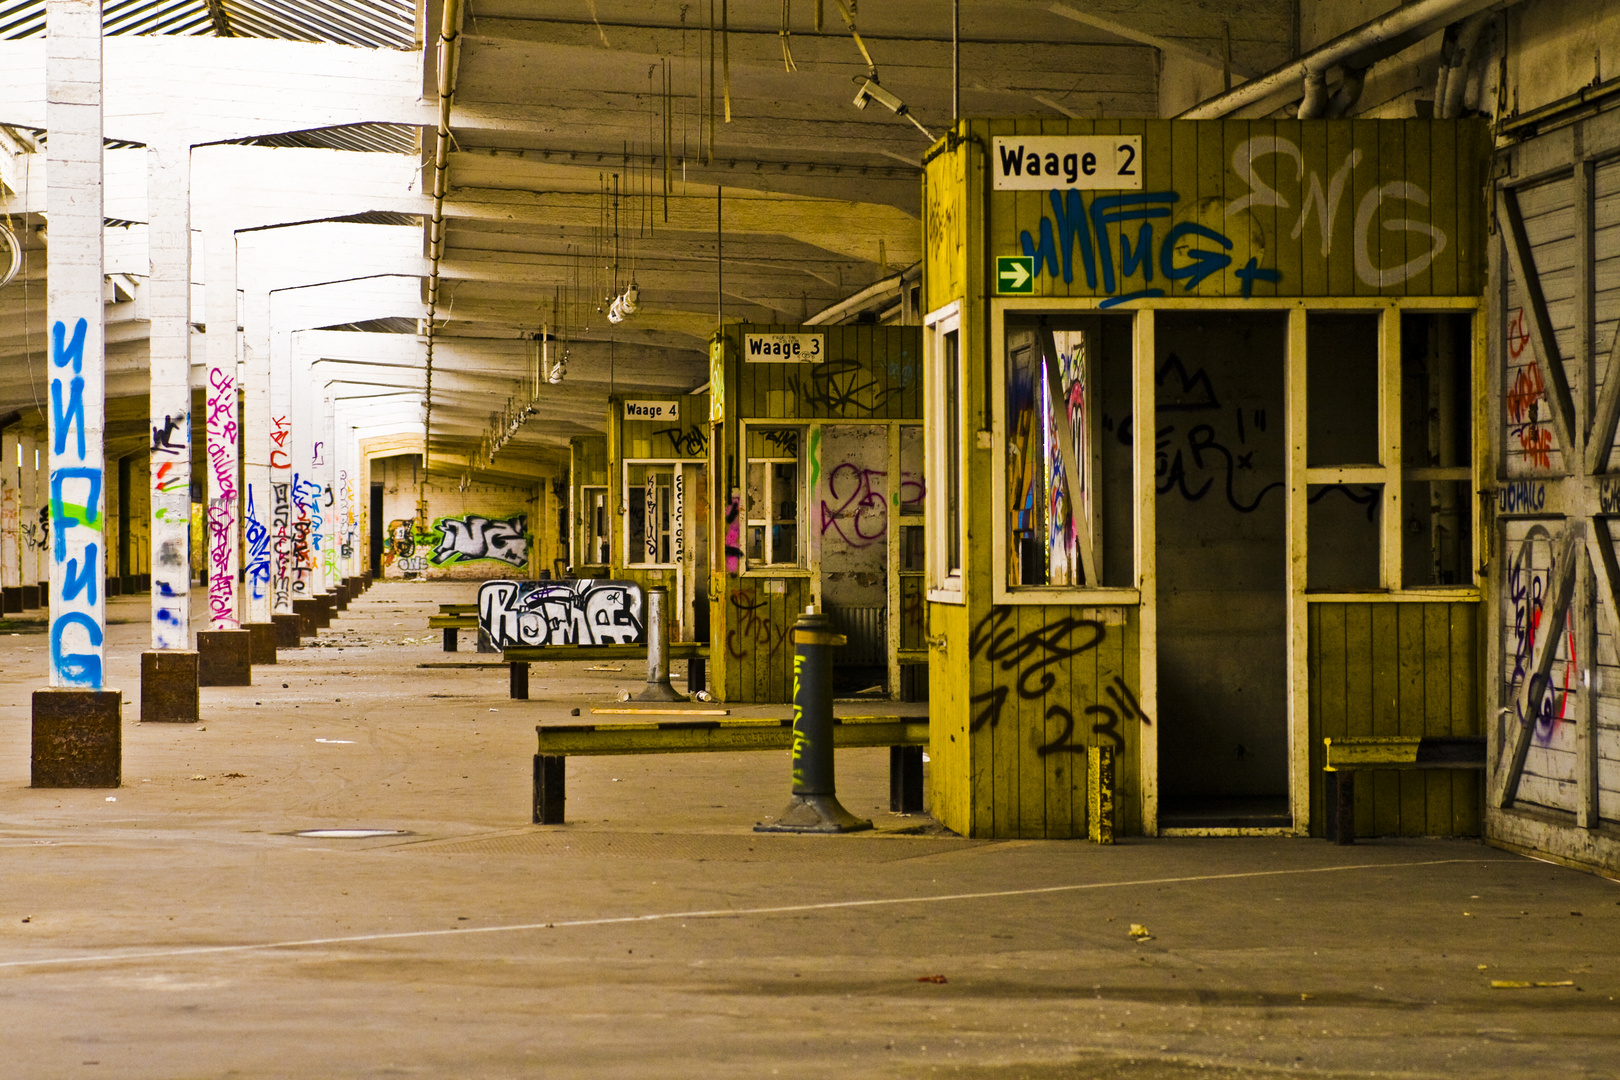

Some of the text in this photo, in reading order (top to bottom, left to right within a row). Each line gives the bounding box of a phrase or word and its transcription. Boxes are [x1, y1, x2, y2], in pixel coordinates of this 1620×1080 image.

[999, 143, 1138, 184] Waage 2
[749, 338, 801, 360] Waage
[810, 338, 821, 355] 3
[626, 403, 678, 419] Waage 4
